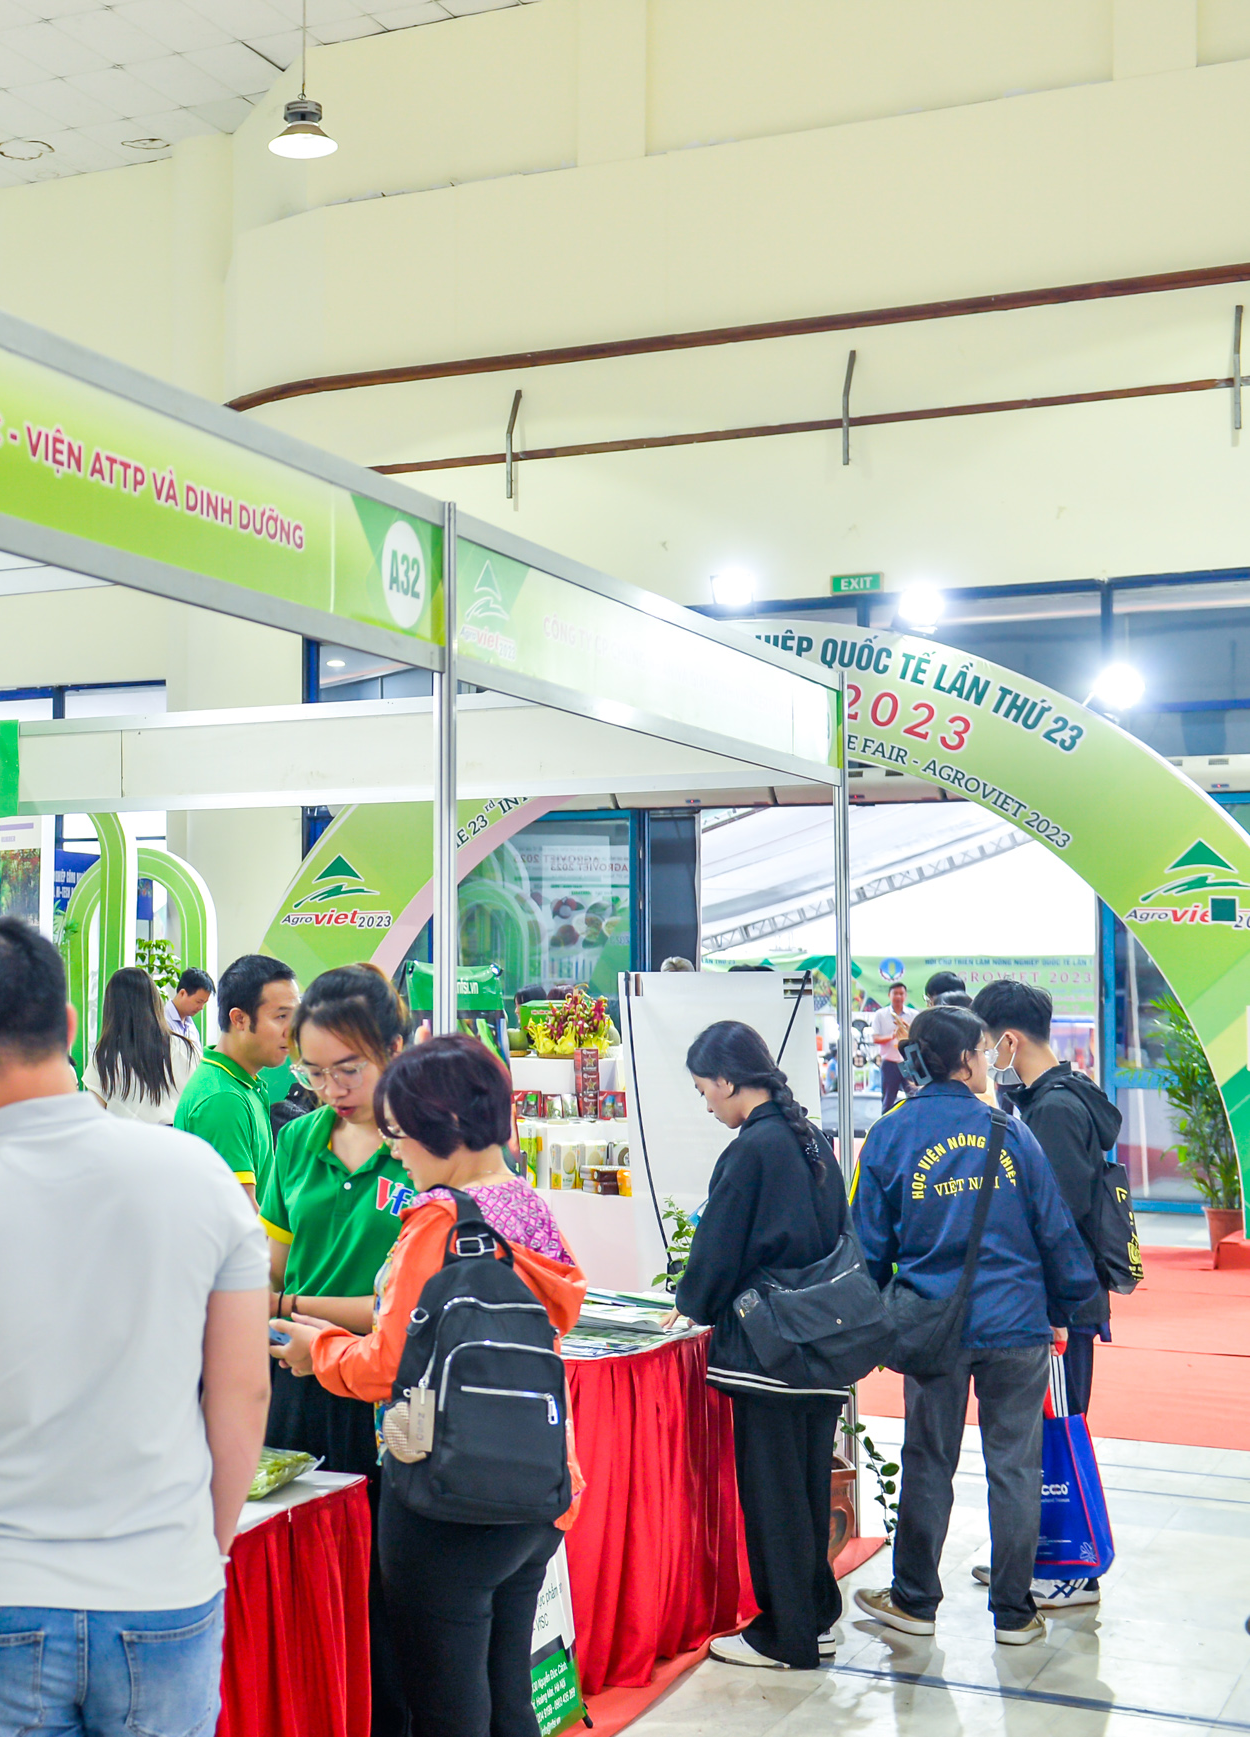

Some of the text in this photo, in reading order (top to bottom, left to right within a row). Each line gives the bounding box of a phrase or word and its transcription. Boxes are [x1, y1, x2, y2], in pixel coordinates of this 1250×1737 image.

[25, 425, 83, 474] VIỆN
[89, 450, 146, 493] ATTP
[151, 468, 180, 508] VÀ
[184, 483, 233, 527] DINH
[238, 503, 305, 550] DƯỠNG
[388, 549, 422, 601] A32
[840, 575, 873, 592] EXIT
[820, 635, 893, 675] QUỐC
[898, 651, 937, 686] TẾ
[932, 661, 991, 707] LẦN
[991, 685, 1053, 730] THỨ
[1042, 715, 1085, 752] 23
[846, 682, 972, 752] 2023
[860, 737, 909, 766] FAIR
[922, 758, 1028, 819] AGROVIET
[1024, 810, 1072, 849] 2023
[357, 915, 392, 928] 2023
[1125, 904, 1210, 923] Agrovie
[946, 1132, 987, 1151] NÔNG
[917, 1142, 948, 1171] VIỆN
[911, 1172, 927, 1200] HỌC
[933, 1176, 965, 1197] VIỆT
